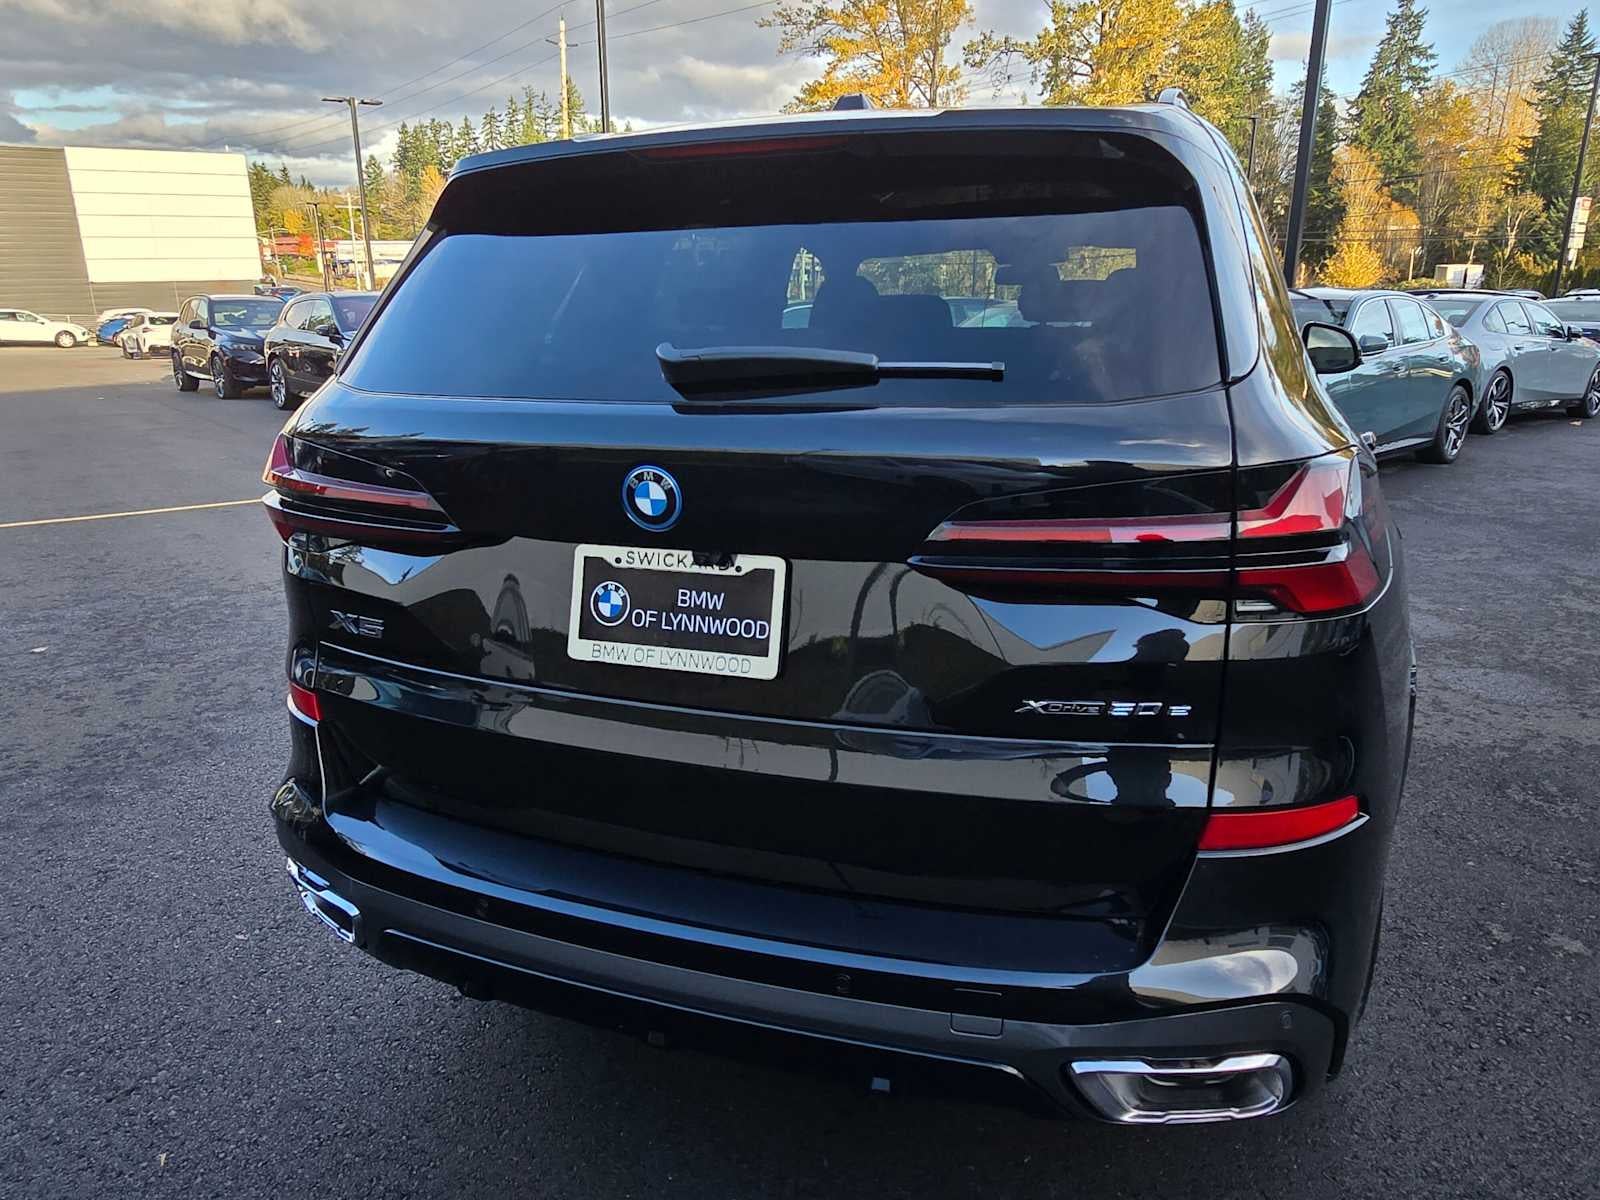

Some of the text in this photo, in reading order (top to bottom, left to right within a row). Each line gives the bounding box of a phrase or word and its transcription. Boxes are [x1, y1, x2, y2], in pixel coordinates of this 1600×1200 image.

[629, 471, 672, 490] BMW
[625, 550, 731, 571] SWICK
[596, 583, 626, 598] BMW
[677, 588, 725, 611] BMW
[328, 609, 384, 638] X5
[631, 609, 770, 640] OF LYNNWOOD
[591, 643, 752, 674] BMW OF LYNNWOOD
